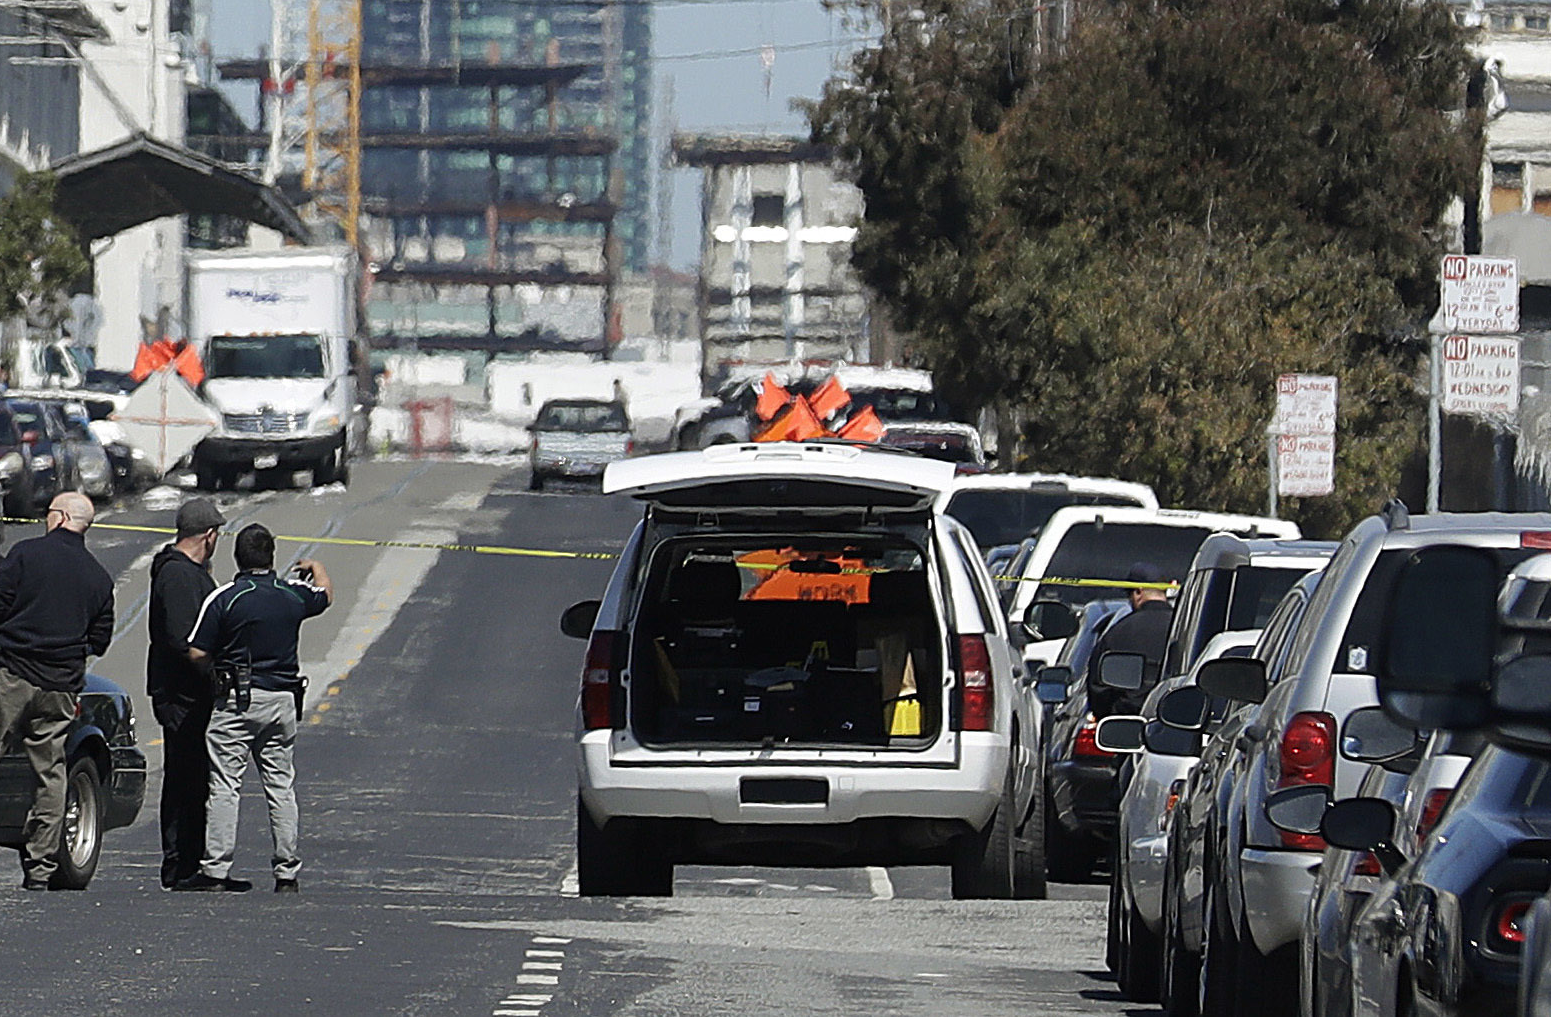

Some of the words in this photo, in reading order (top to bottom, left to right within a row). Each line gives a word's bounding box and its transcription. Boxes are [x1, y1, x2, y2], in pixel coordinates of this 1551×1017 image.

[1446, 258, 1465, 277] NO
[1469, 263, 1514, 277] PARKING
[1446, 338, 1466, 359] NO
[1470, 344, 1516, 358] PARKING
